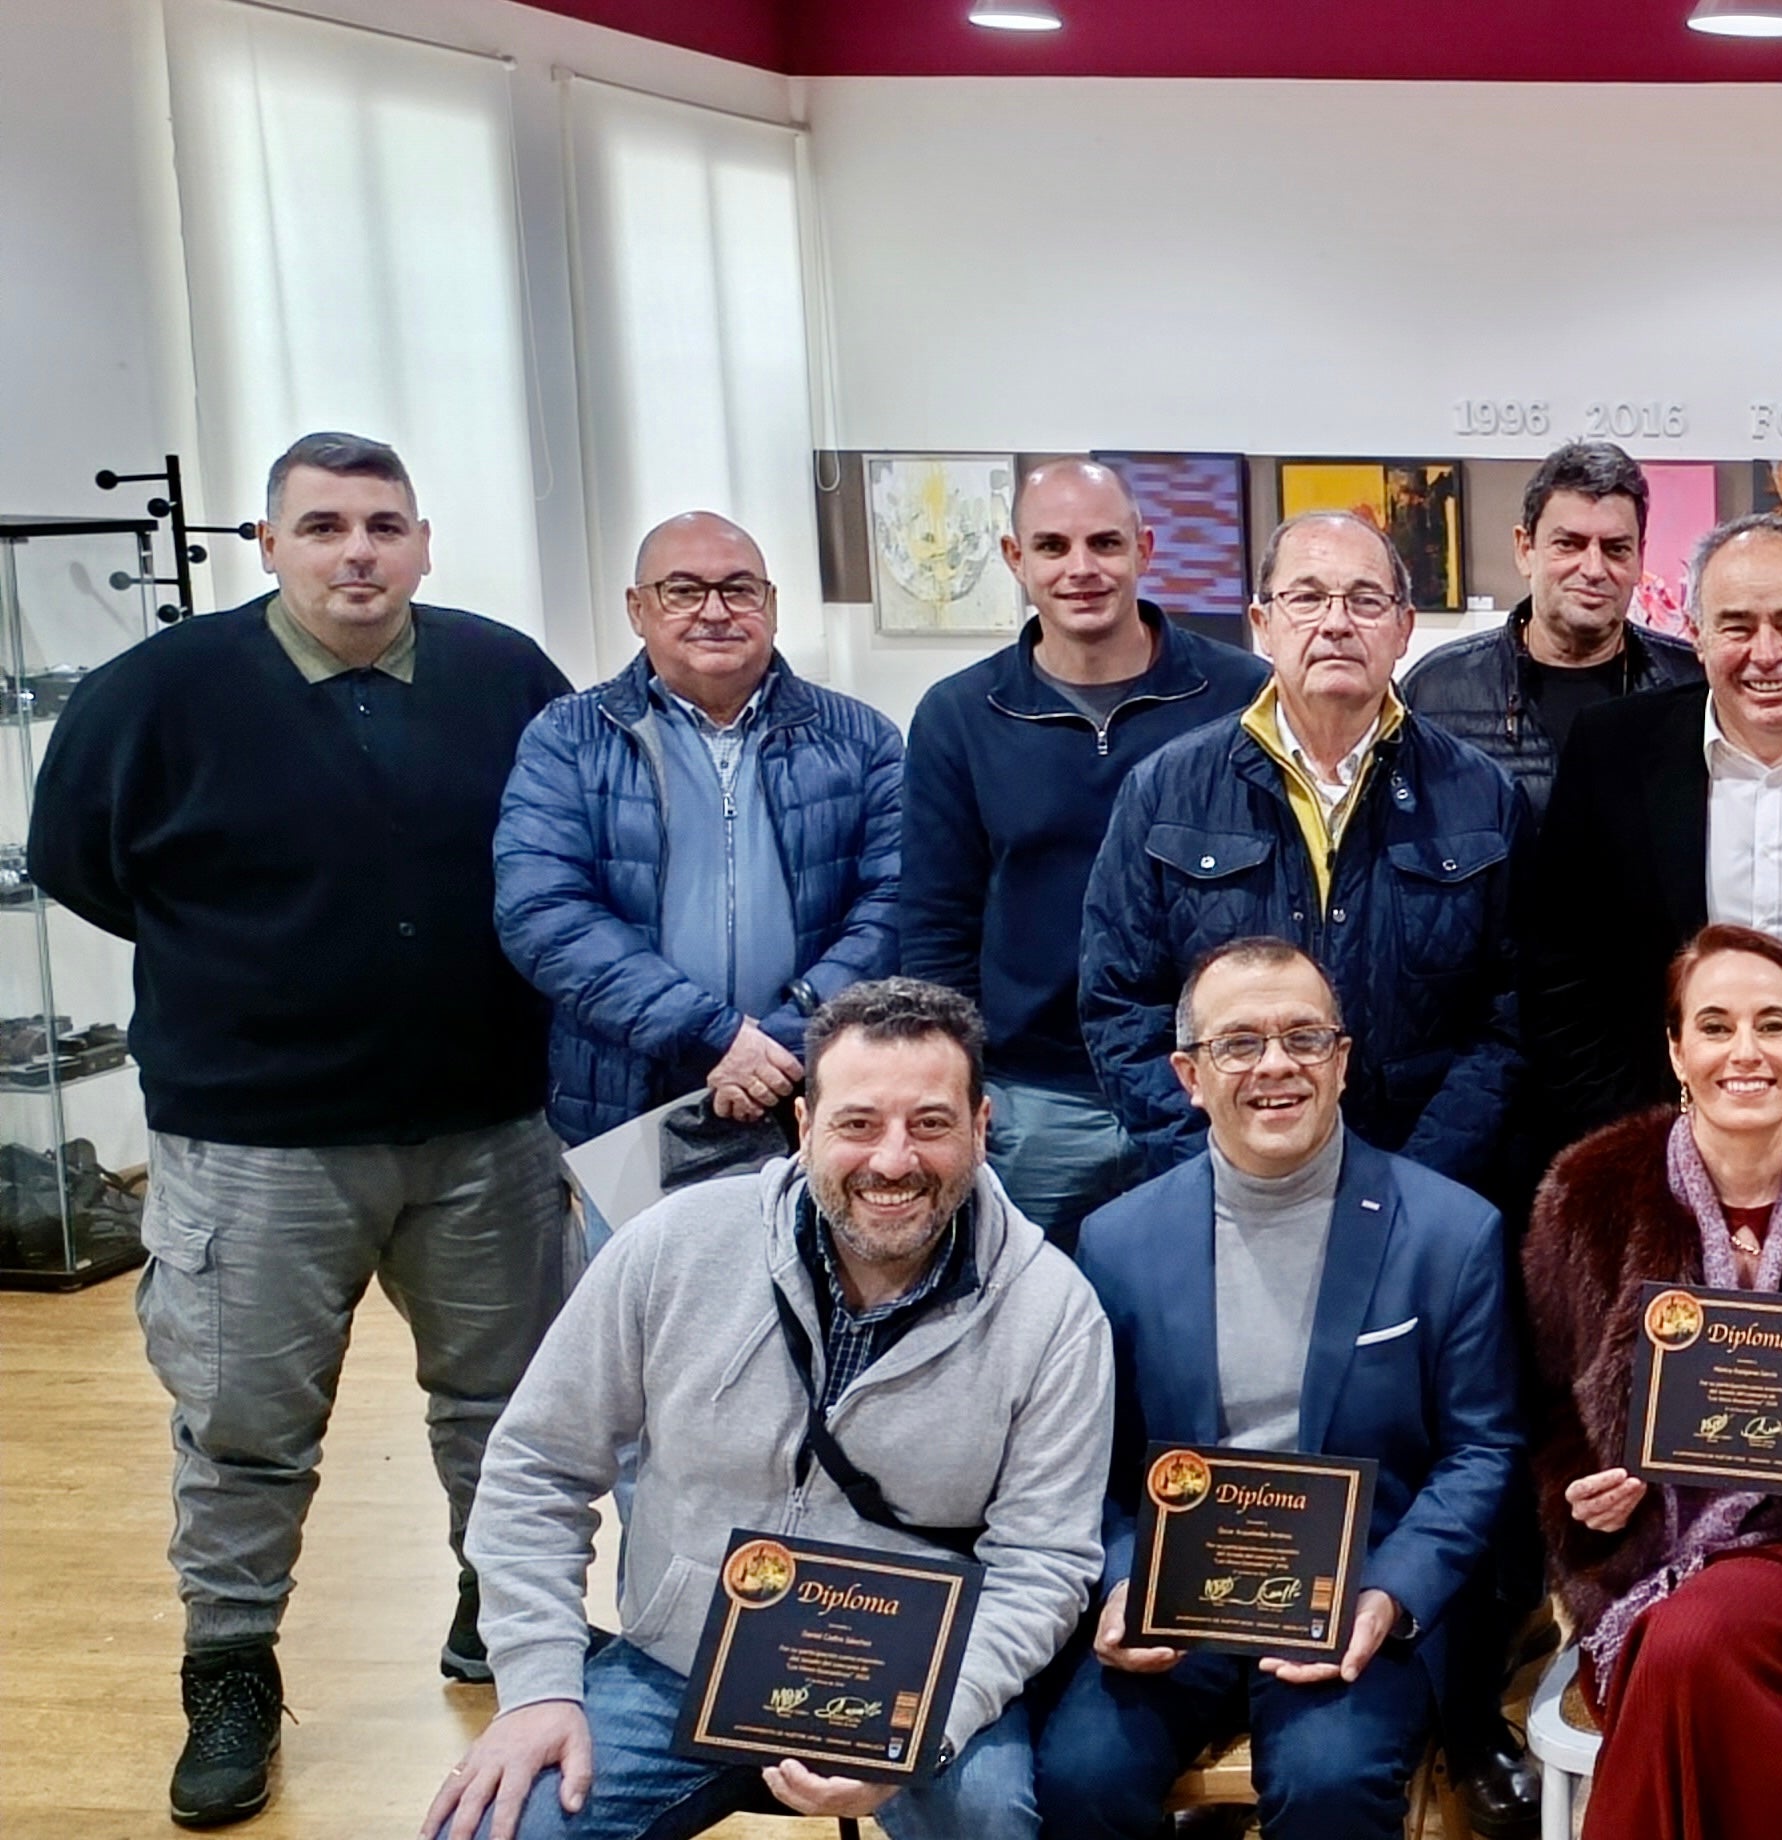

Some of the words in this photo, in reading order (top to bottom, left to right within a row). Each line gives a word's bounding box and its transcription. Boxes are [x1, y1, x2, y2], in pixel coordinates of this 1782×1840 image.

[1454, 399, 1550, 437] 1996
[1586, 400, 1687, 438] 2016
[1215, 1482, 1307, 1514] Diploma
[797, 1580, 900, 1616] Diploma
